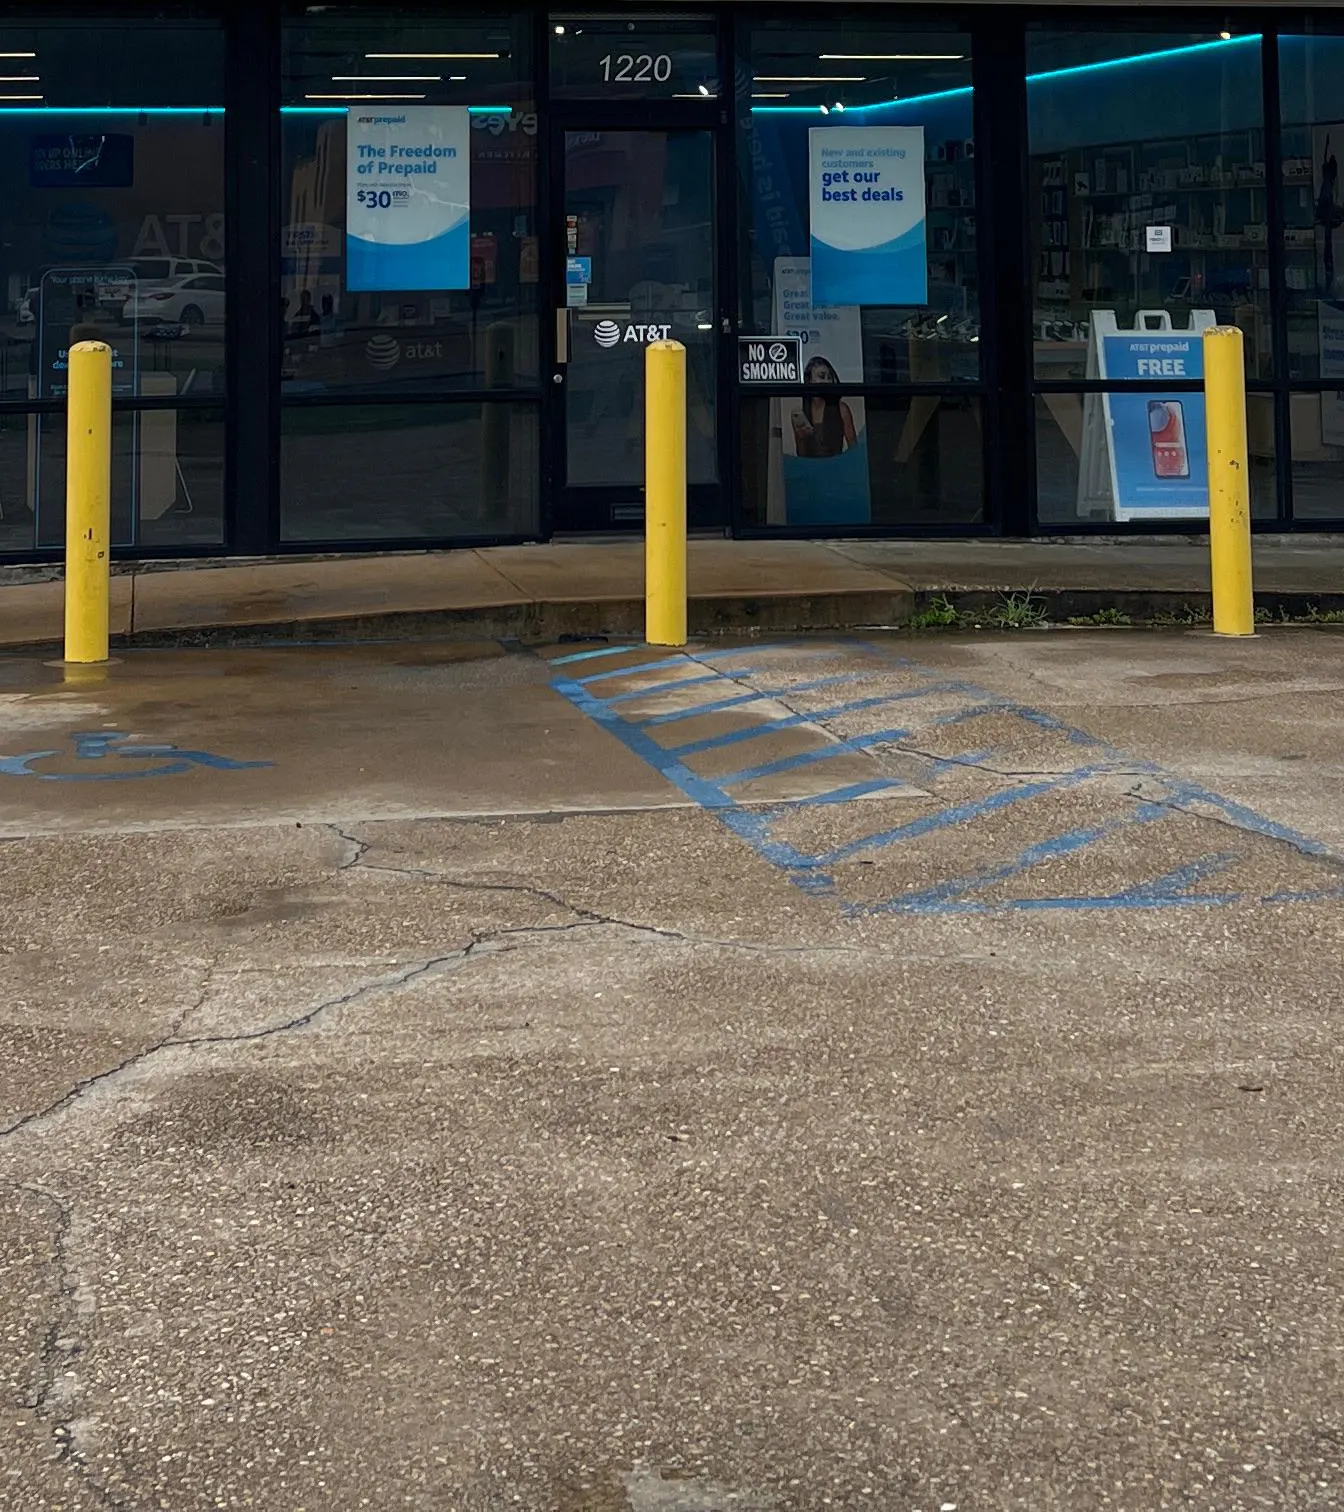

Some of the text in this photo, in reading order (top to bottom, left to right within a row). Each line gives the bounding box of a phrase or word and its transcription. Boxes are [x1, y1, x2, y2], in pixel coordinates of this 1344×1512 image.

[599, 54, 672, 82] 1220
[357, 144, 457, 158] The Freedom
[821, 148, 906, 159] New and existing
[357, 161, 437, 177] of Prepaid
[821, 160, 874, 168] customers
[822, 170, 881, 186] get our
[357, 190, 391, 208] $30
[822, 187, 903, 201] best deals
[131, 213, 225, 260] AT&
[784, 312, 810, 321] Great
[623, 324, 672, 342] AT&T
[406, 341, 443, 359] at&t
[748, 343, 765, 361] NO
[742, 362, 796, 381] SMOKING
[1137, 359, 1186, 376] FREE
